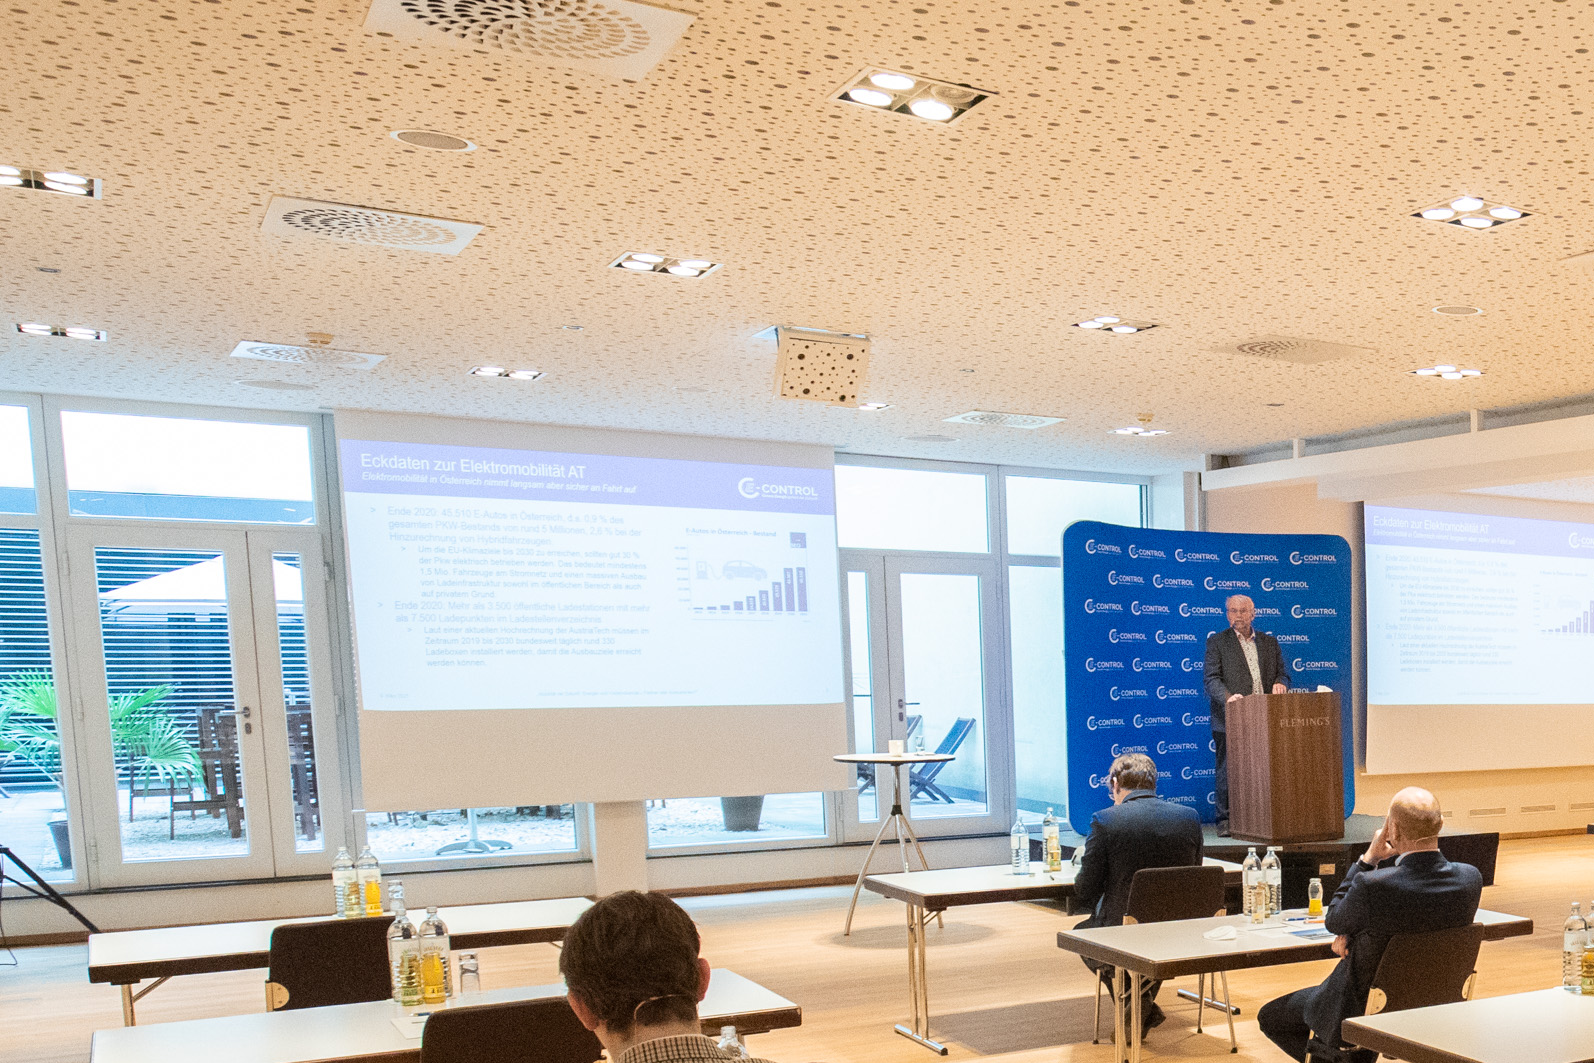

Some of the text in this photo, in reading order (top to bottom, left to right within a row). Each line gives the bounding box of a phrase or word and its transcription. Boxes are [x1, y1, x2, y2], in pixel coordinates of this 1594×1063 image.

[360, 453, 586, 478] Eckdaten zur Elektromobilität AT
[387, 505, 411, 515] Ende
[441, 508, 472, 518] 45.510
[473, 509, 508, 519] E-Autos
[509, 511, 517, 519] in
[599, 514, 607, 523] %
[609, 515, 624, 524] des
[1373, 514, 1489, 535] Eckdaten zur Elektromobilität AT
[387, 519, 433, 531] gesamten
[434, 520, 500, 531] PKW-Bestands
[520, 523, 540, 532] rund
[541, 524, 547, 533] 5
[628, 528, 641, 536] der
